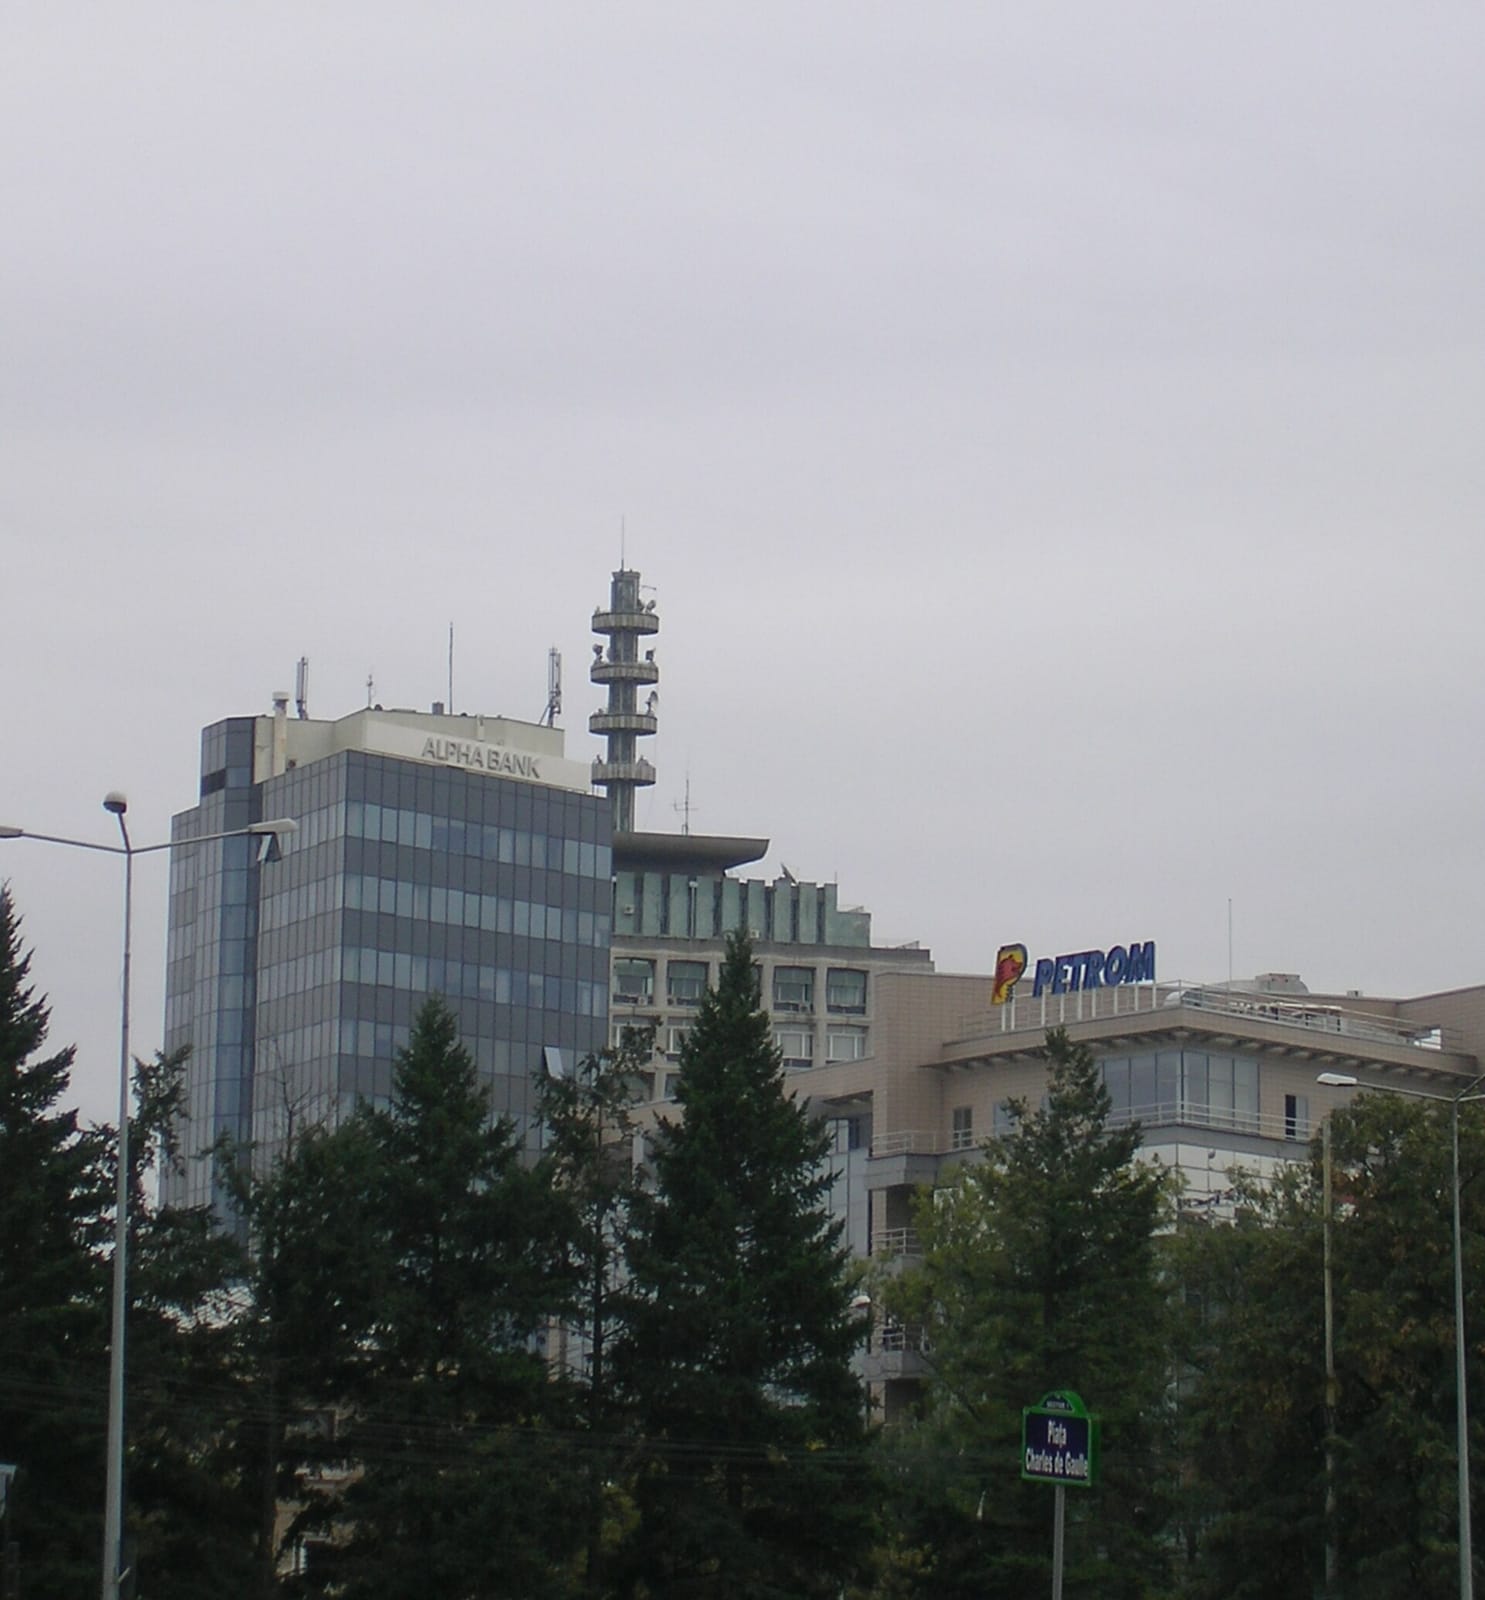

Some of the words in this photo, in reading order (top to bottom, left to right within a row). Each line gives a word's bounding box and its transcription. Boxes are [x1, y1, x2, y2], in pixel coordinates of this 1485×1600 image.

[421, 737, 484, 768] ALPHA
[486, 748, 541, 780] BANK
[1032, 940, 1156, 998] PETROM
[1025, 1447, 1053, 1474] Charles
[1054, 1450, 1064, 1475] de
[1065, 1451, 1088, 1478] Gaulle
